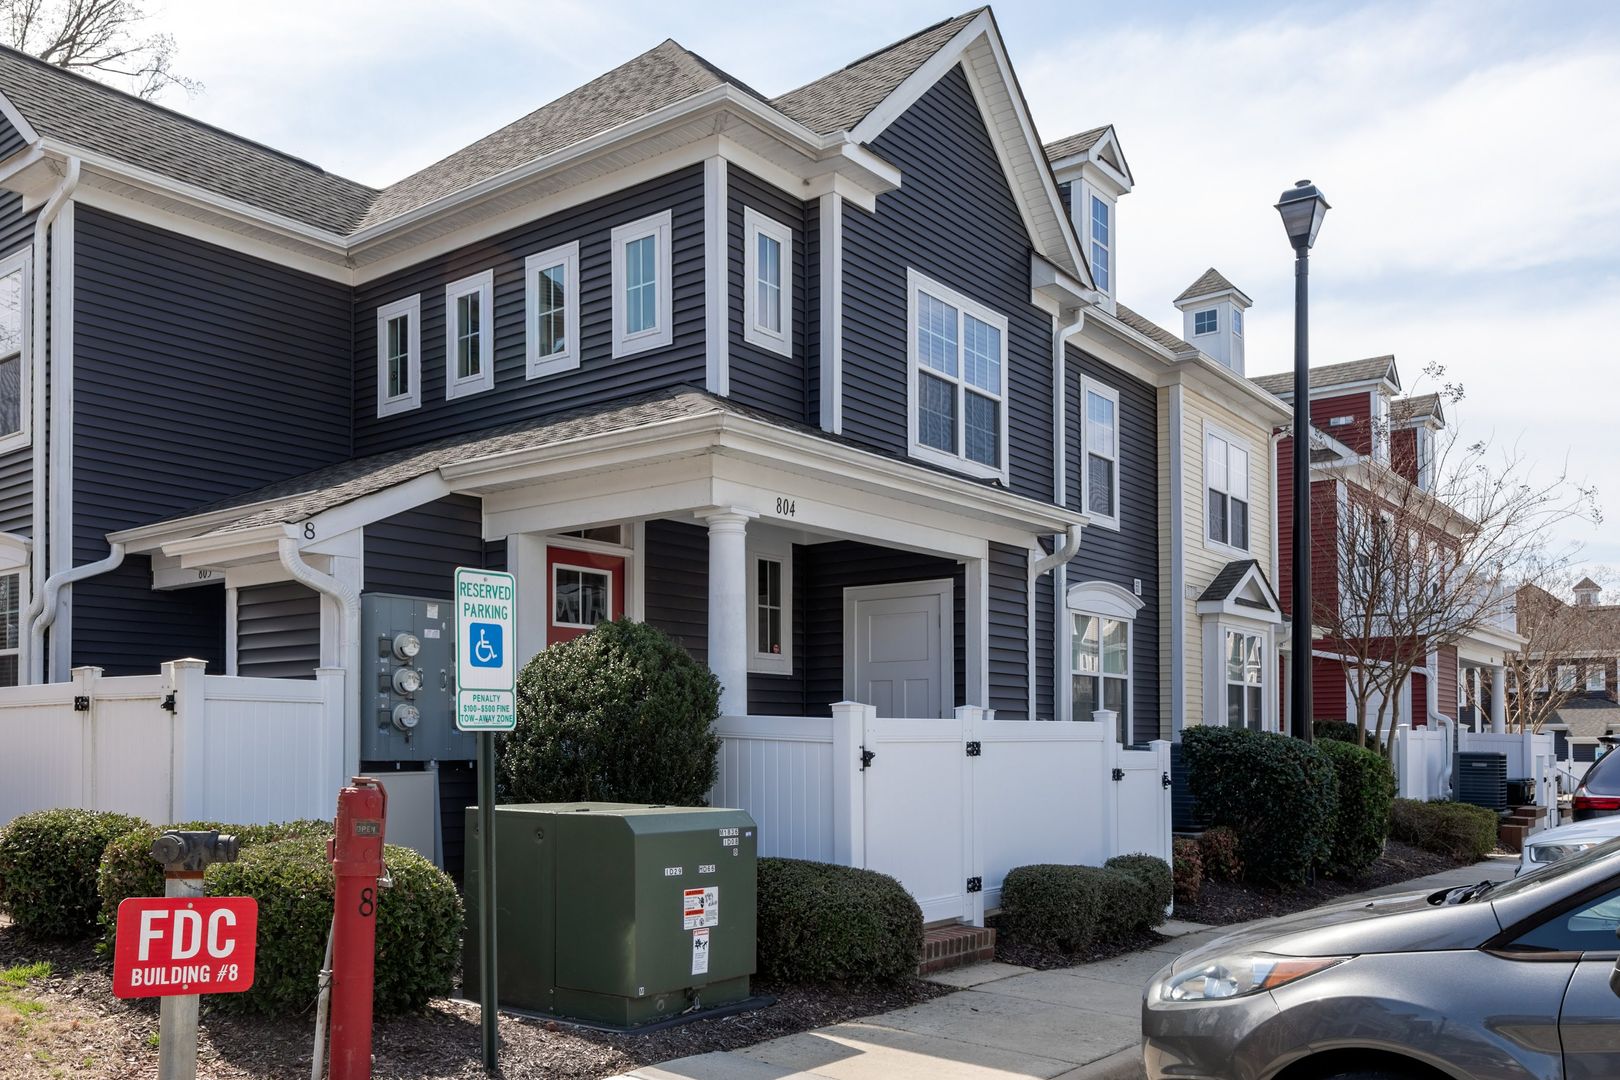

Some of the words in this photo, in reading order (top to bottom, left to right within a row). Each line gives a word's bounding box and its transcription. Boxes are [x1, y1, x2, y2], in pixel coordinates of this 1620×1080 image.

[776, 497, 795, 517] 804
[304, 522, 315, 539] 8
[460, 581, 511, 601] RESERVED
[464, 602, 508, 620] PARKING
[472, 694, 501, 703] PENALTY
[496, 705, 510, 713] FINE
[496, 715, 513, 723] ZONE
[356, 825, 376, 834] OPEN
[359, 887, 374, 917] 8
[138, 908, 237, 961] FDC
[131, 965, 211, 987] BUILDING
[216, 964, 239, 982] #8
